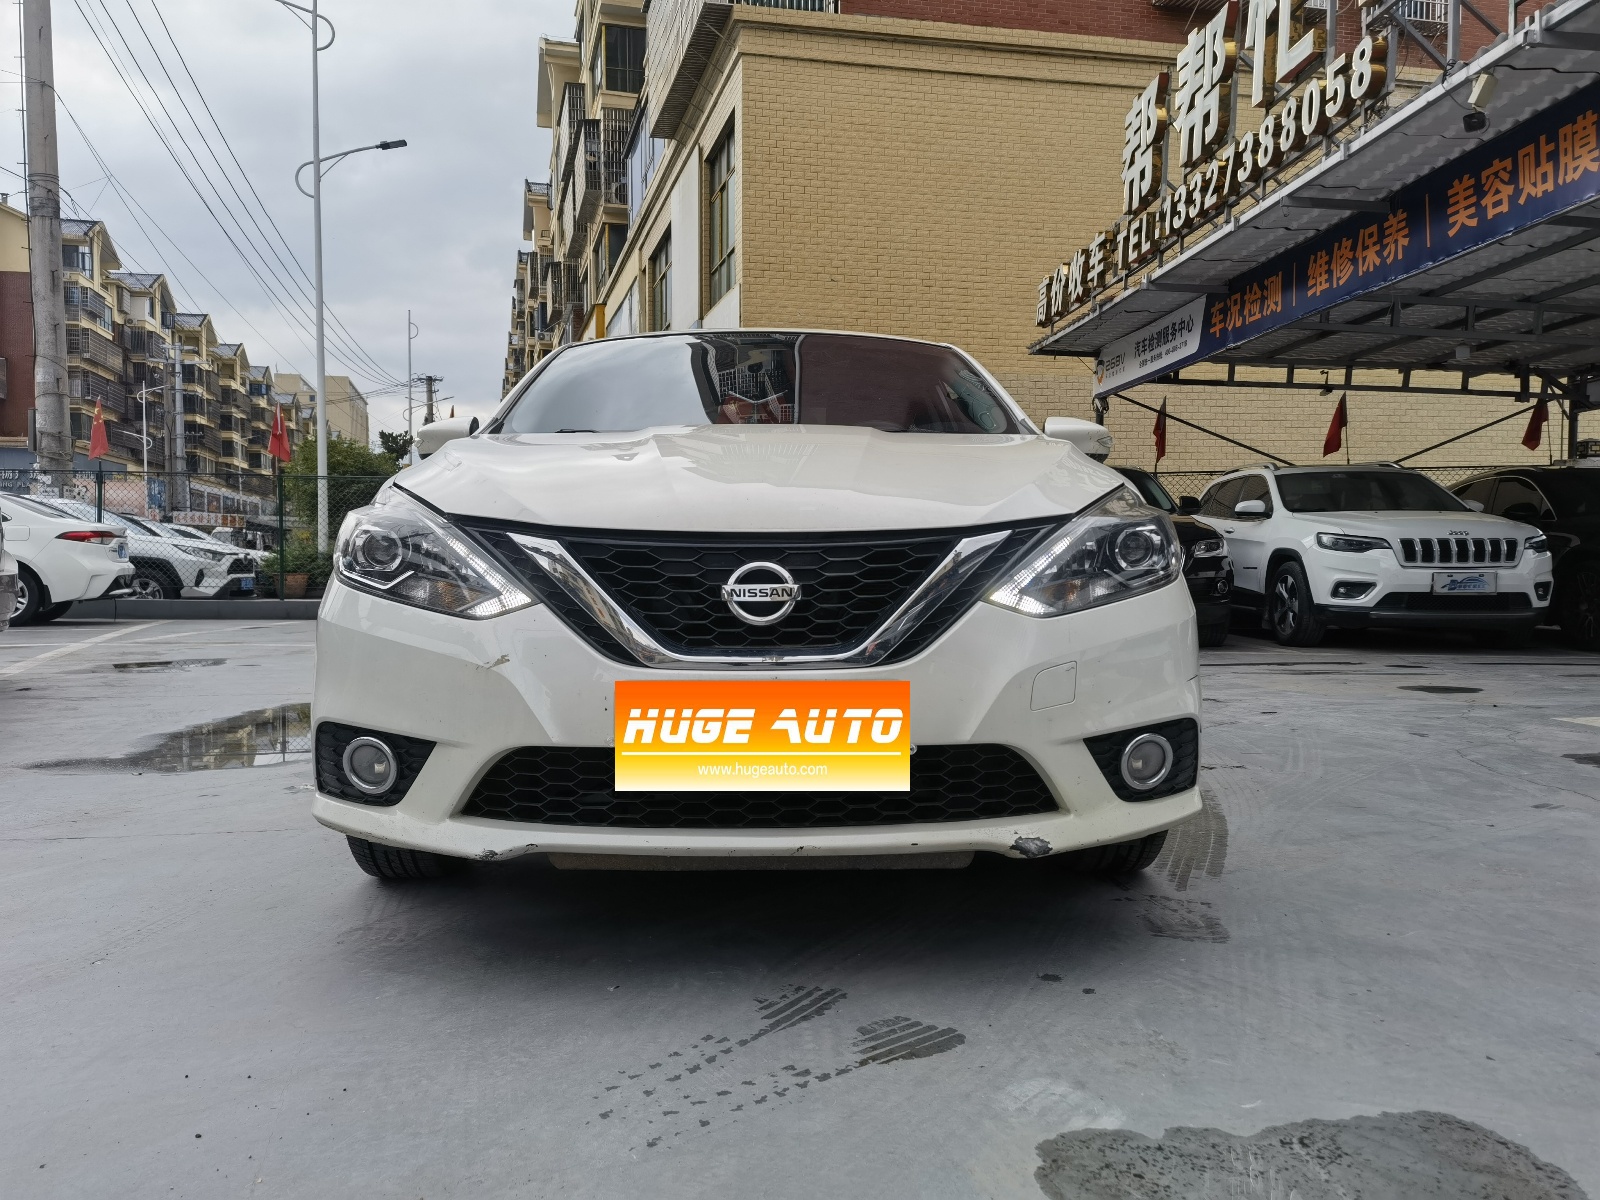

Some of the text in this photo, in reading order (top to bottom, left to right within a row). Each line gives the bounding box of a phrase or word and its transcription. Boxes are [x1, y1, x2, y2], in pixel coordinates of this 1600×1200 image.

[1209, 110, 1600, 338] 车况检测 维修保养 美容贴膜
[1036, 231, 1107, 326] 高价收车
[1133, 314, 1195, 359] 汽车检测服务中心
[730, 588, 793, 598] NISSAN
